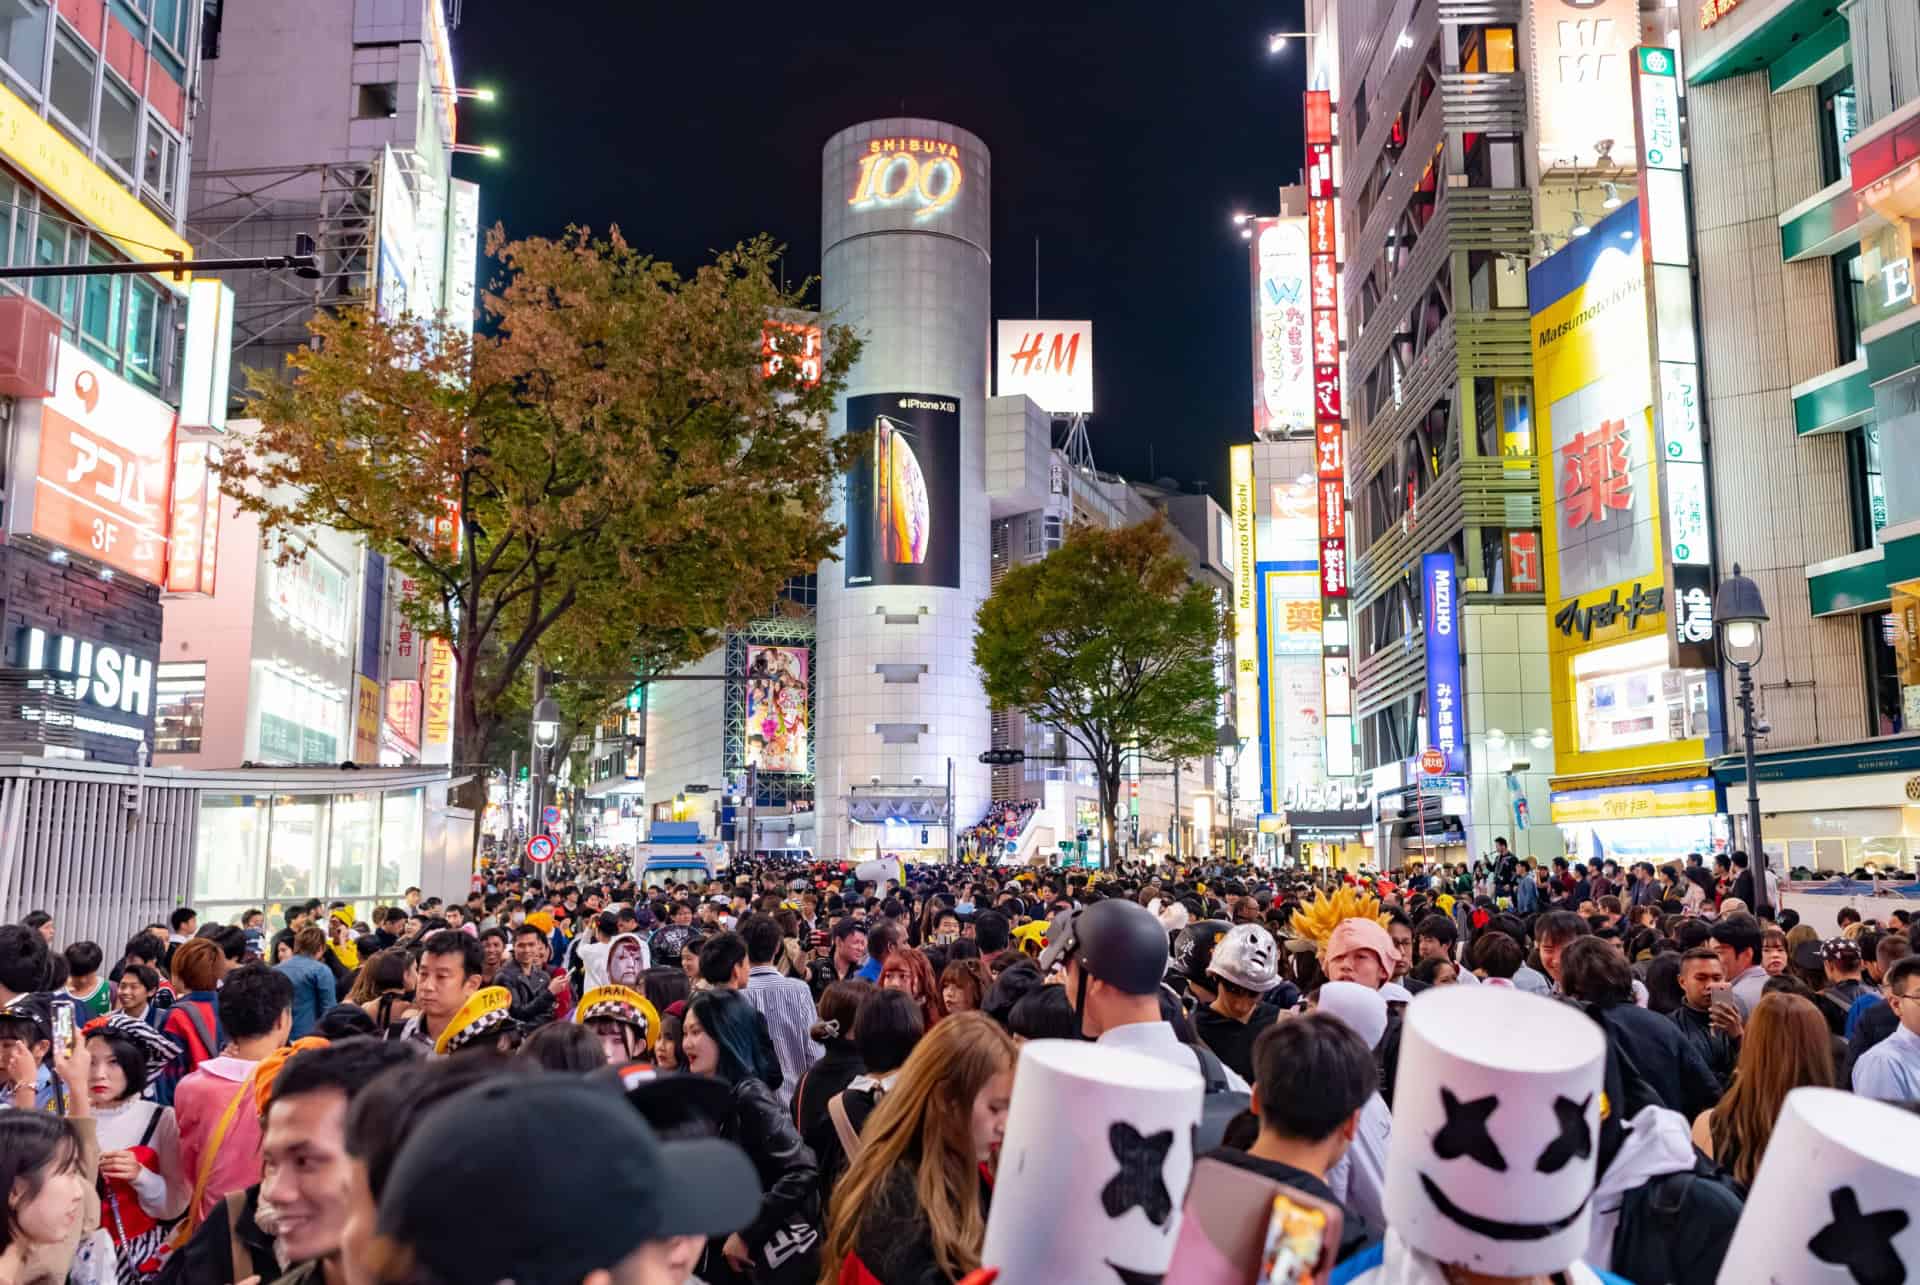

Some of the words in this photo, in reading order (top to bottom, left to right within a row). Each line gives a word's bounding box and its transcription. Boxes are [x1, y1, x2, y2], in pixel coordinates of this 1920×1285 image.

[870, 139, 959, 159] SHIBUYA
[848, 153, 963, 225] 109
[1010, 331, 1080, 377] H&M
[67, 431, 150, 517] アコム
[1562, 418, 1634, 530] 薬
[91, 517, 119, 553] 3F
[1435, 569, 1451, 636] MIZUHO
[1555, 582, 1665, 642] マツモトキヨ
